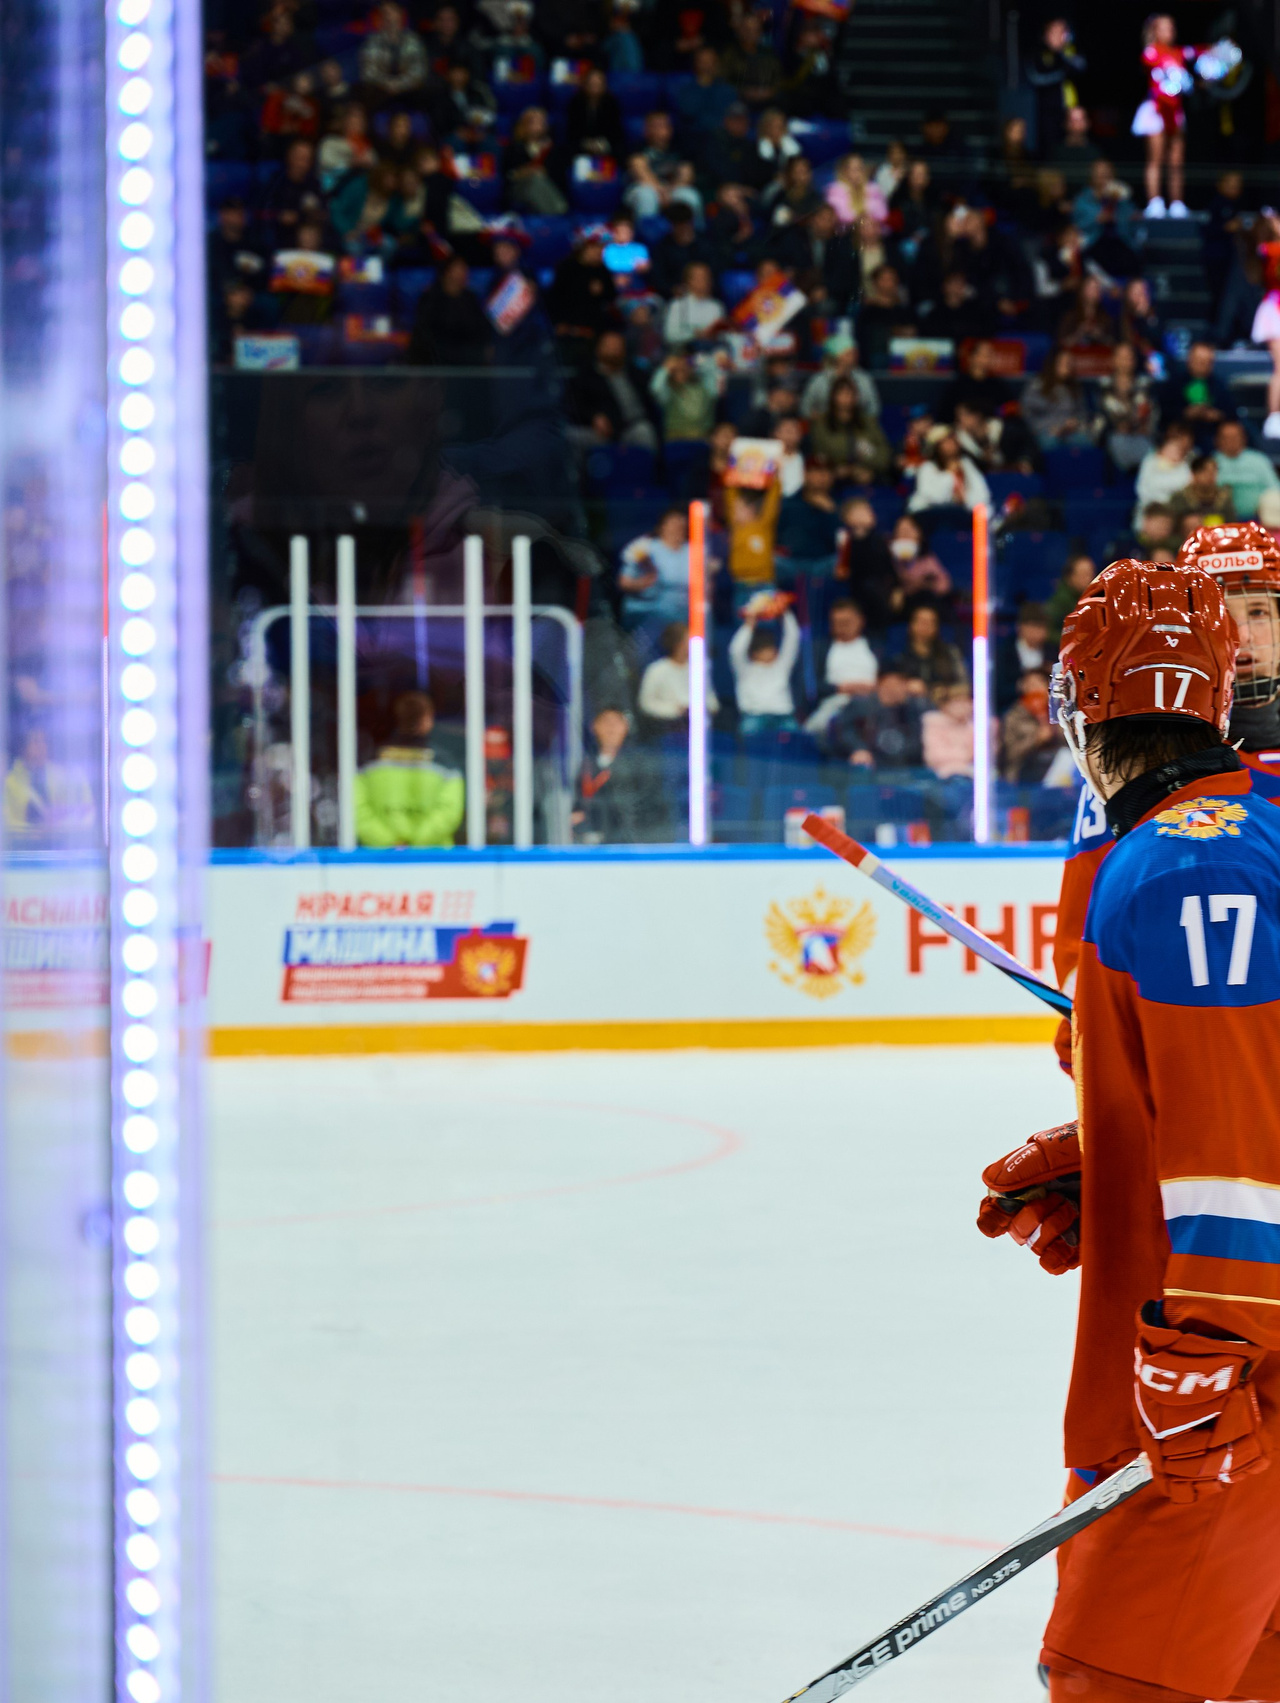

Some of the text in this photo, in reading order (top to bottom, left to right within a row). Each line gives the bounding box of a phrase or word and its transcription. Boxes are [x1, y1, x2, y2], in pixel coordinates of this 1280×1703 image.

[1200, 555, 1261, 571] РОЛЬФ
[1154, 671, 1193, 708] 17
[294, 891, 436, 921] КРАСНАЯ
[288, 926, 438, 965] МАШИНА
[1179, 894, 1258, 988] 17
[831, 1639, 894, 1697] ACE
